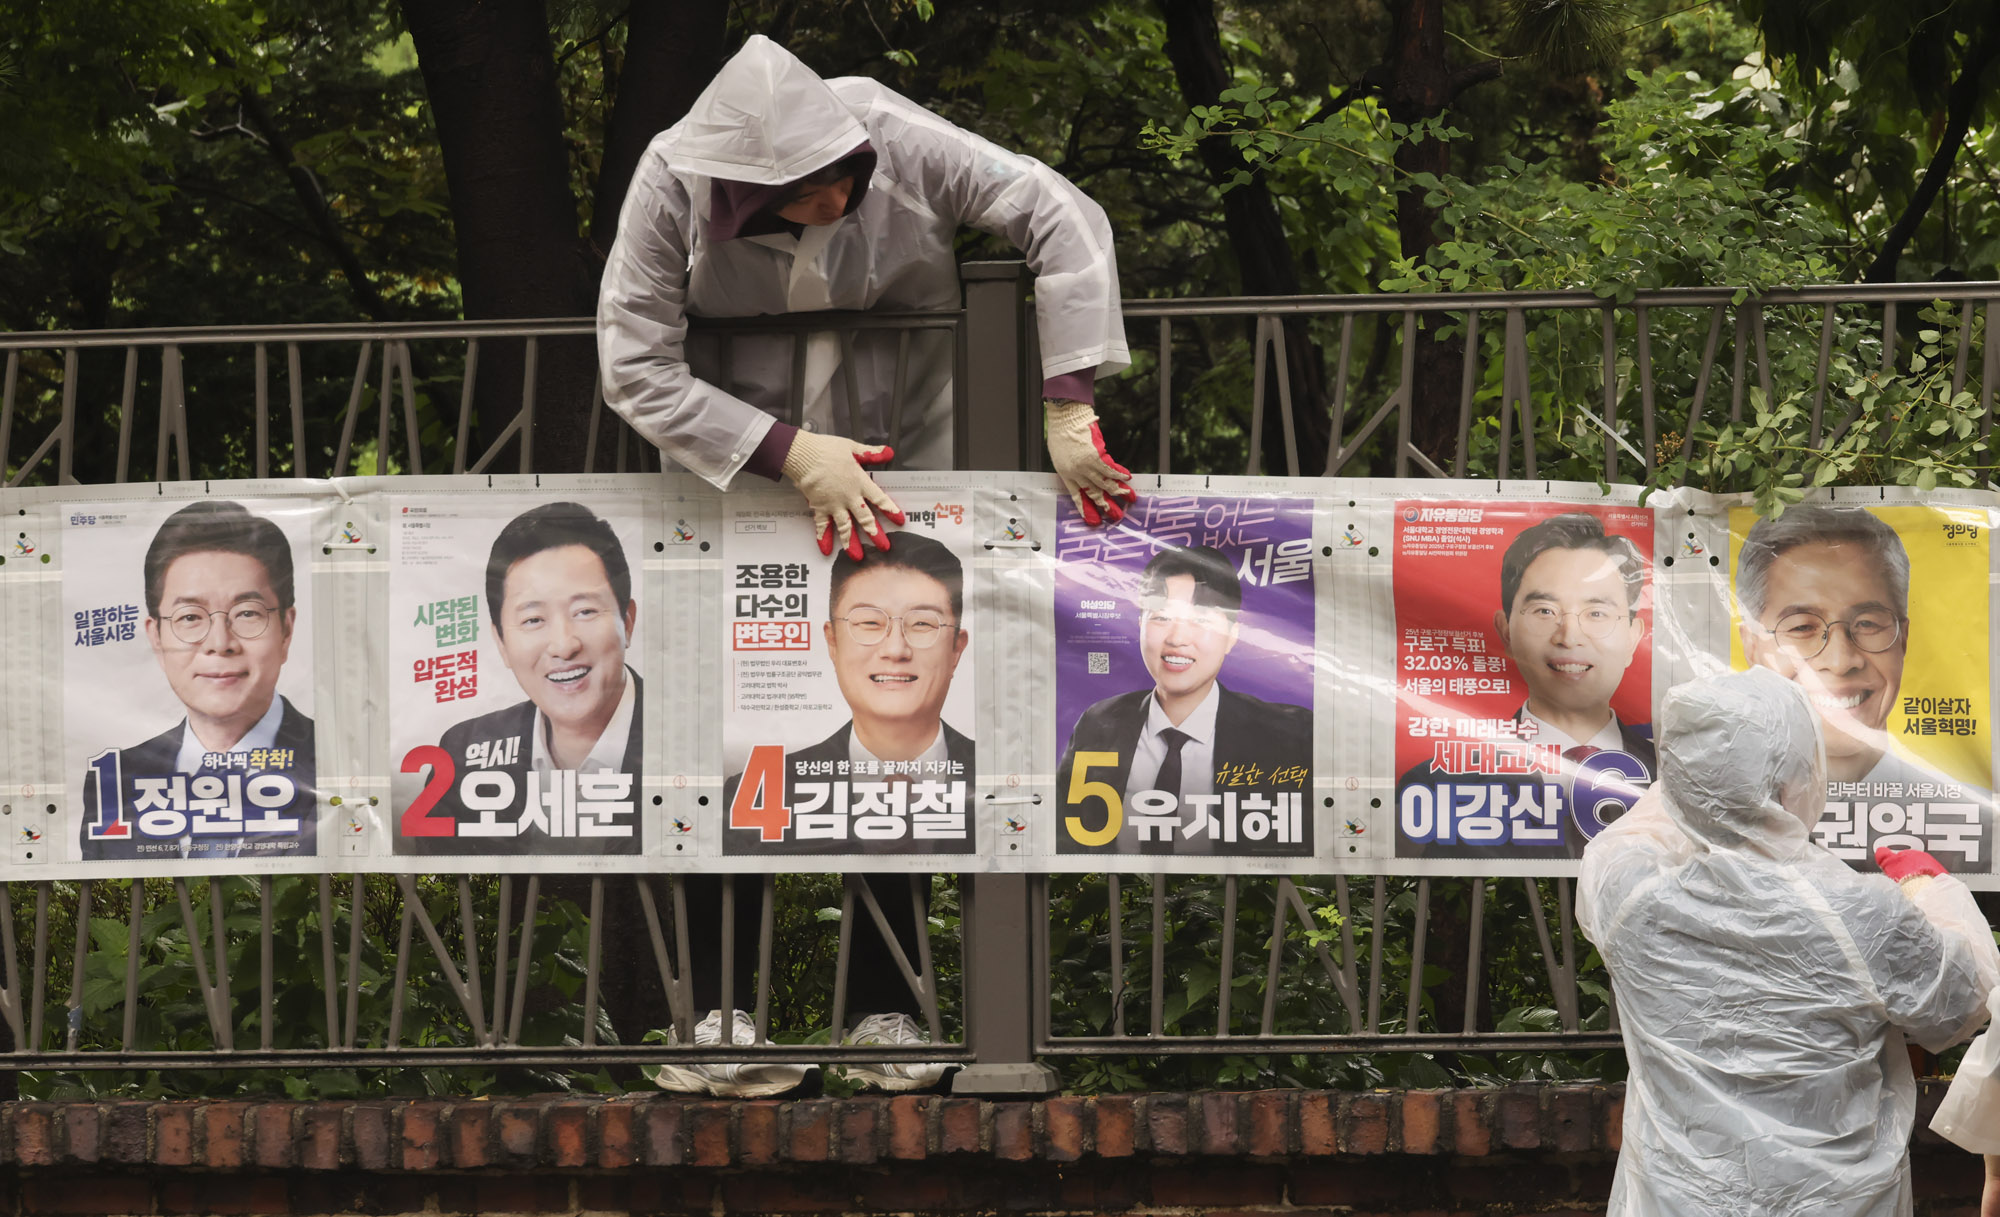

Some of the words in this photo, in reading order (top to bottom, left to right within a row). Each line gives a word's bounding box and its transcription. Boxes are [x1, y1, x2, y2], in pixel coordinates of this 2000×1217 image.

[70, 515, 96, 526] 민주당
[905, 502, 965, 529] 개혁신당
[1419, 507, 1484, 523] 자유통일당
[1402, 526, 1434, 534] 서울대학교
[1435, 526, 1478, 535] 경영전문대학원
[1402, 535, 1420, 543] (SNU
[1421, 535, 1440, 543] MBA)
[1942, 523, 1979, 540] 정의당
[735, 563, 810, 588] 조용한
[1236, 537, 1313, 588] 서울
[74, 610, 90, 630] 일
[91, 604, 139, 627] 잘하는
[413, 594, 478, 628] 시작된
[735, 593, 808, 618] 다수의
[1080, 600, 1116, 610] 여성의당
[74, 621, 136, 647] 서울시장
[435, 619, 480, 648] 변화
[735, 622, 808, 648] 변호인
[1403, 635, 1449, 653] 구로구
[1451, 637, 1486, 653] 득표!
[1405, 628, 1420, 636] 25년
[1472, 631, 1484, 639] 후보
[413, 649, 478, 683] 압도적
[1403, 655, 1469, 671] 32.03%
[1472, 655, 1507, 673] 돌풍!
[434, 674, 478, 704] 완성
[1403, 677, 1446, 696] 서울의
[1449, 677, 1511, 696] 태풍으로!
[1903, 697, 1972, 716] 같이살자
[1408, 716, 1450, 738] 강한
[1456, 717, 1538, 740] 미래보수
[1903, 717, 1977, 736] 서울혁명!
[203, 753, 247, 769] 하나씩
[250, 749, 295, 769] 착착!
[465, 735, 521, 769] 역시!
[1429, 740, 1561, 776] 세대교체
[795, 760, 834, 776] 당신의
[836, 760, 850, 776] 한
[853, 760, 880, 775] 표를
[882, 760, 922, 775] 끝까지
[925, 760, 964, 775] 지키는
[1216, 761, 1265, 787] 유일한
[1267, 765, 1309, 789] 선택
[87, 747, 132, 839] 1
[400, 744, 455, 837] 2
[457, 767, 635, 837] 오세훈
[729, 743, 792, 842] 4
[1064, 750, 1123, 847] 5
[1568, 749, 1652, 843] 6
[1826, 782, 1872, 798] 리부터
[1873, 782, 1903, 798] 바꿀
[1905, 782, 1962, 799] 서울시장
[133, 774, 299, 836] 정원오
[793, 779, 967, 841] 김정철
[1128, 789, 1303, 843] 유지혜
[1401, 783, 1563, 842] 이강산
[1811, 801, 1983, 863] 권영국
[145, 844, 158, 852] 민선
